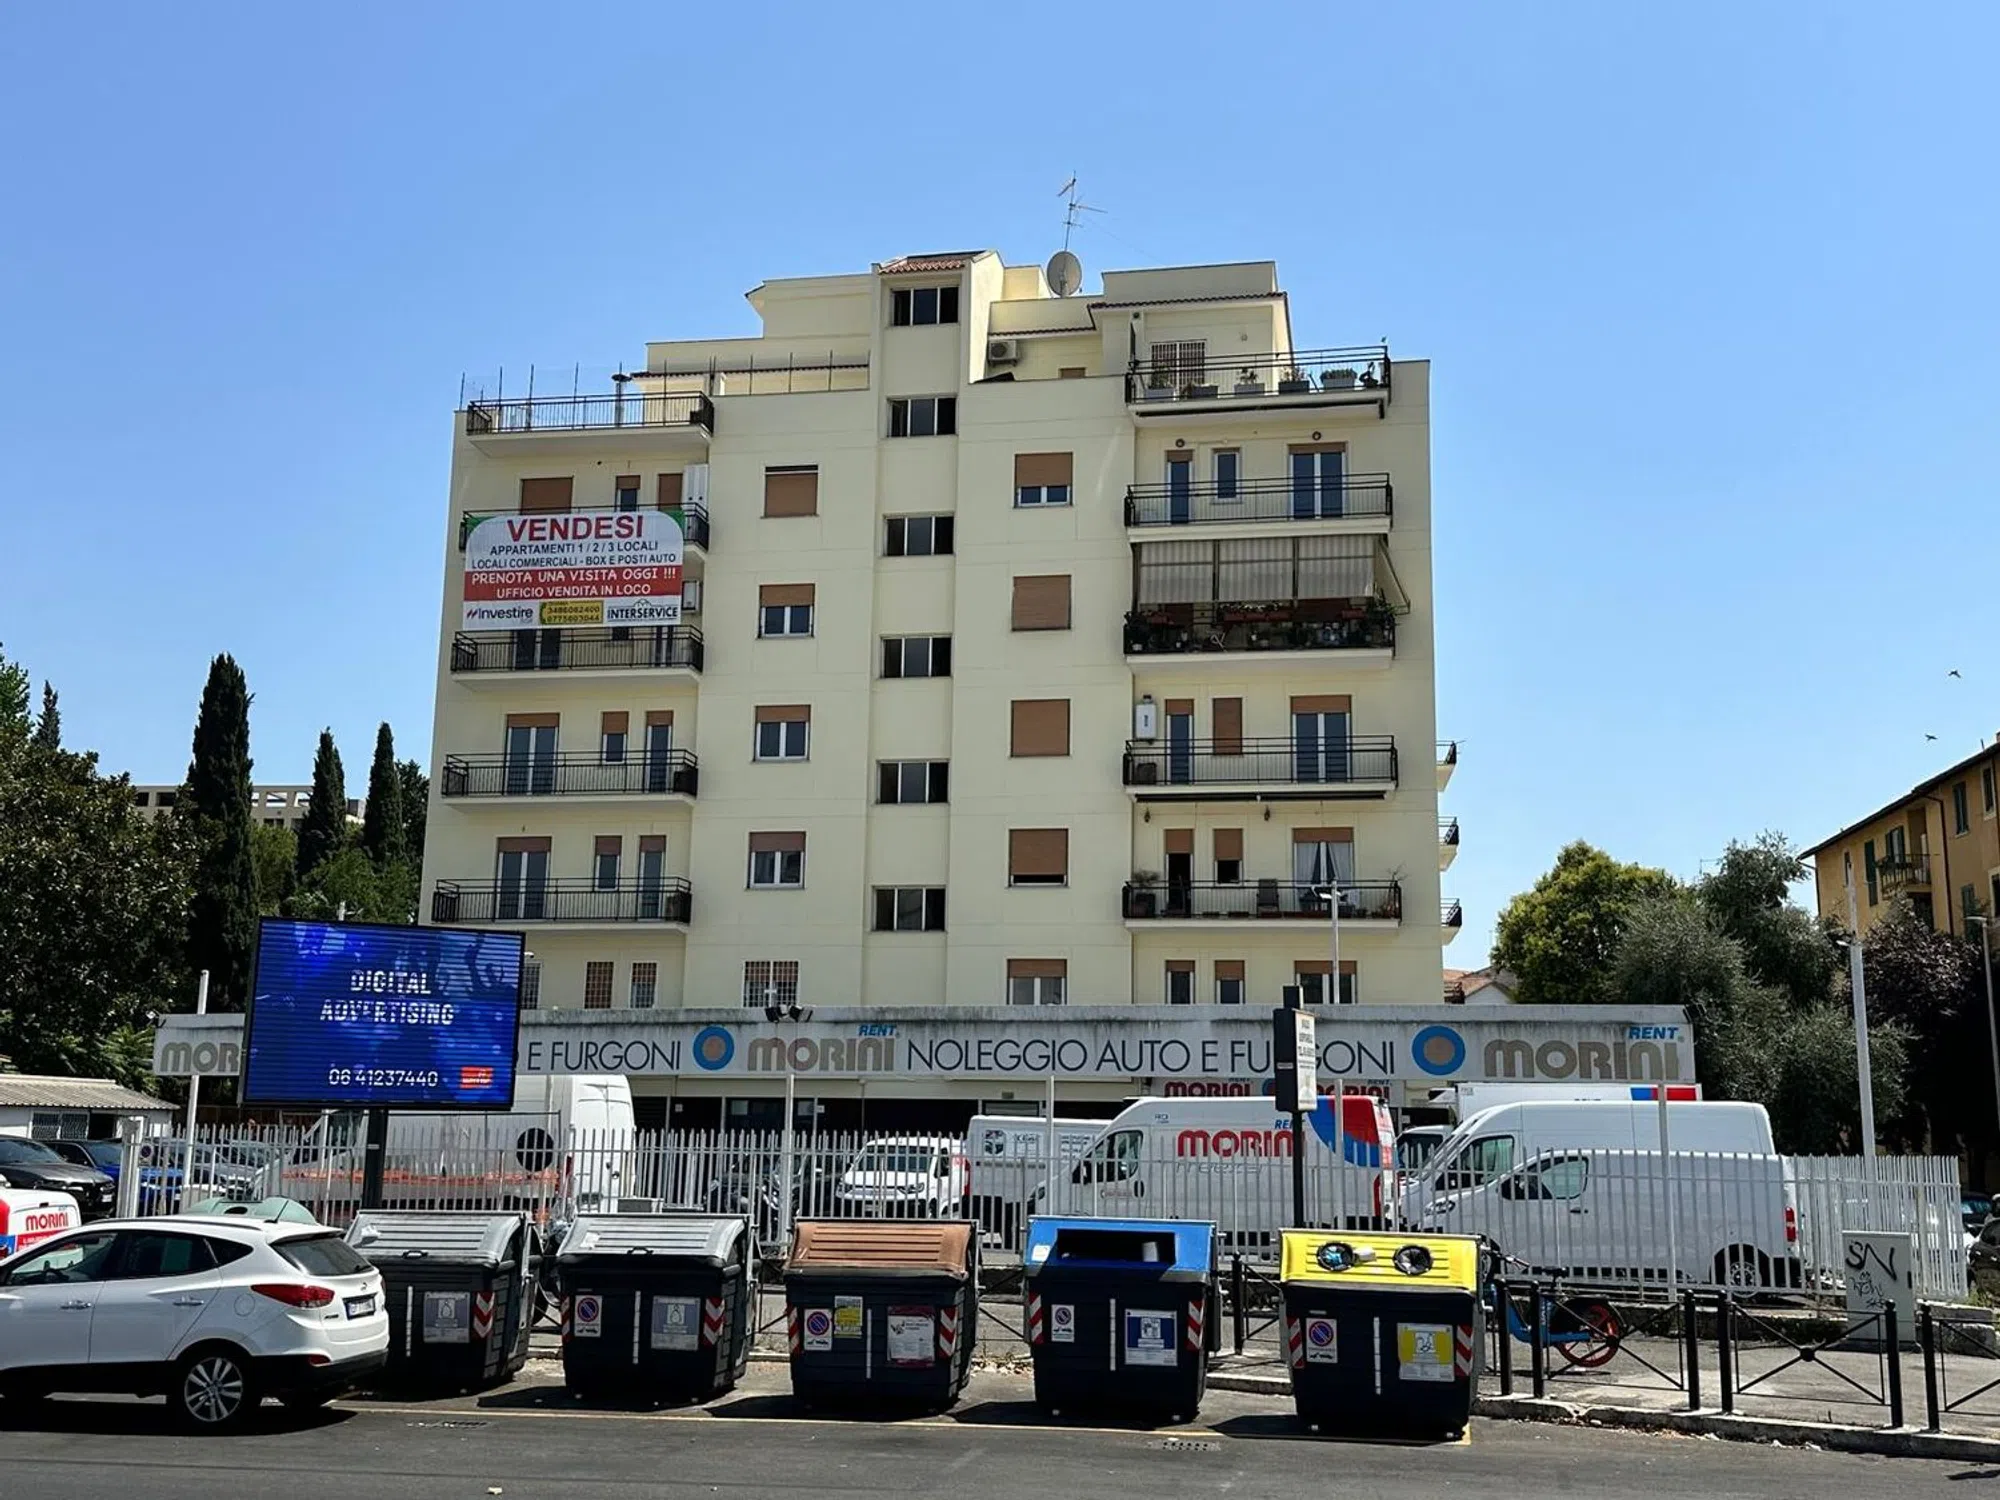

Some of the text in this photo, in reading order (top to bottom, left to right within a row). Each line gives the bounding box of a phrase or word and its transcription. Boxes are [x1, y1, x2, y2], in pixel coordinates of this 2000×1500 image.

[507, 515, 644, 542] VENDESI
[490, 543, 576, 556] APPARTAMENTI
[578, 544, 584, 553] 1
[593, 543, 600, 553] 2
[608, 542, 615, 552] 3
[617, 541, 659, 552] LOCALI
[472, 558, 508, 570] LOCALI
[510, 557, 578, 568] COMMERCIALI
[586, 555, 607, 567] BOX
[609, 555, 615, 565] E
[618, 554, 648, 565] POSTI
[649, 553, 677, 564] AUTO
[472, 567, 677, 585] PRENOTA UNA VISITA OGGI !!!
[497, 584, 651, 599] UFFICIO VENDITA IN LOCO
[479, 606, 534, 619] Investire
[607, 606, 678, 619] INTERSERVICE
[351, 970, 431, 995] DIGITAL
[320, 999, 455, 1026] ADVERTISING
[858, 1025, 898, 1036] RENT
[1629, 1027, 1679, 1040] RENT
[528, 1041, 680, 1071] E FURGONI
[748, 1037, 894, 1072] MORINI
[908, 1039, 1394, 1075] NOLEGGIO AUTO E FUONI
[1484, 1039, 1679, 1080] MORINI
[329, 1068, 439, 1087] 06 41237440
[26, 1212, 69, 1231] MORINI
